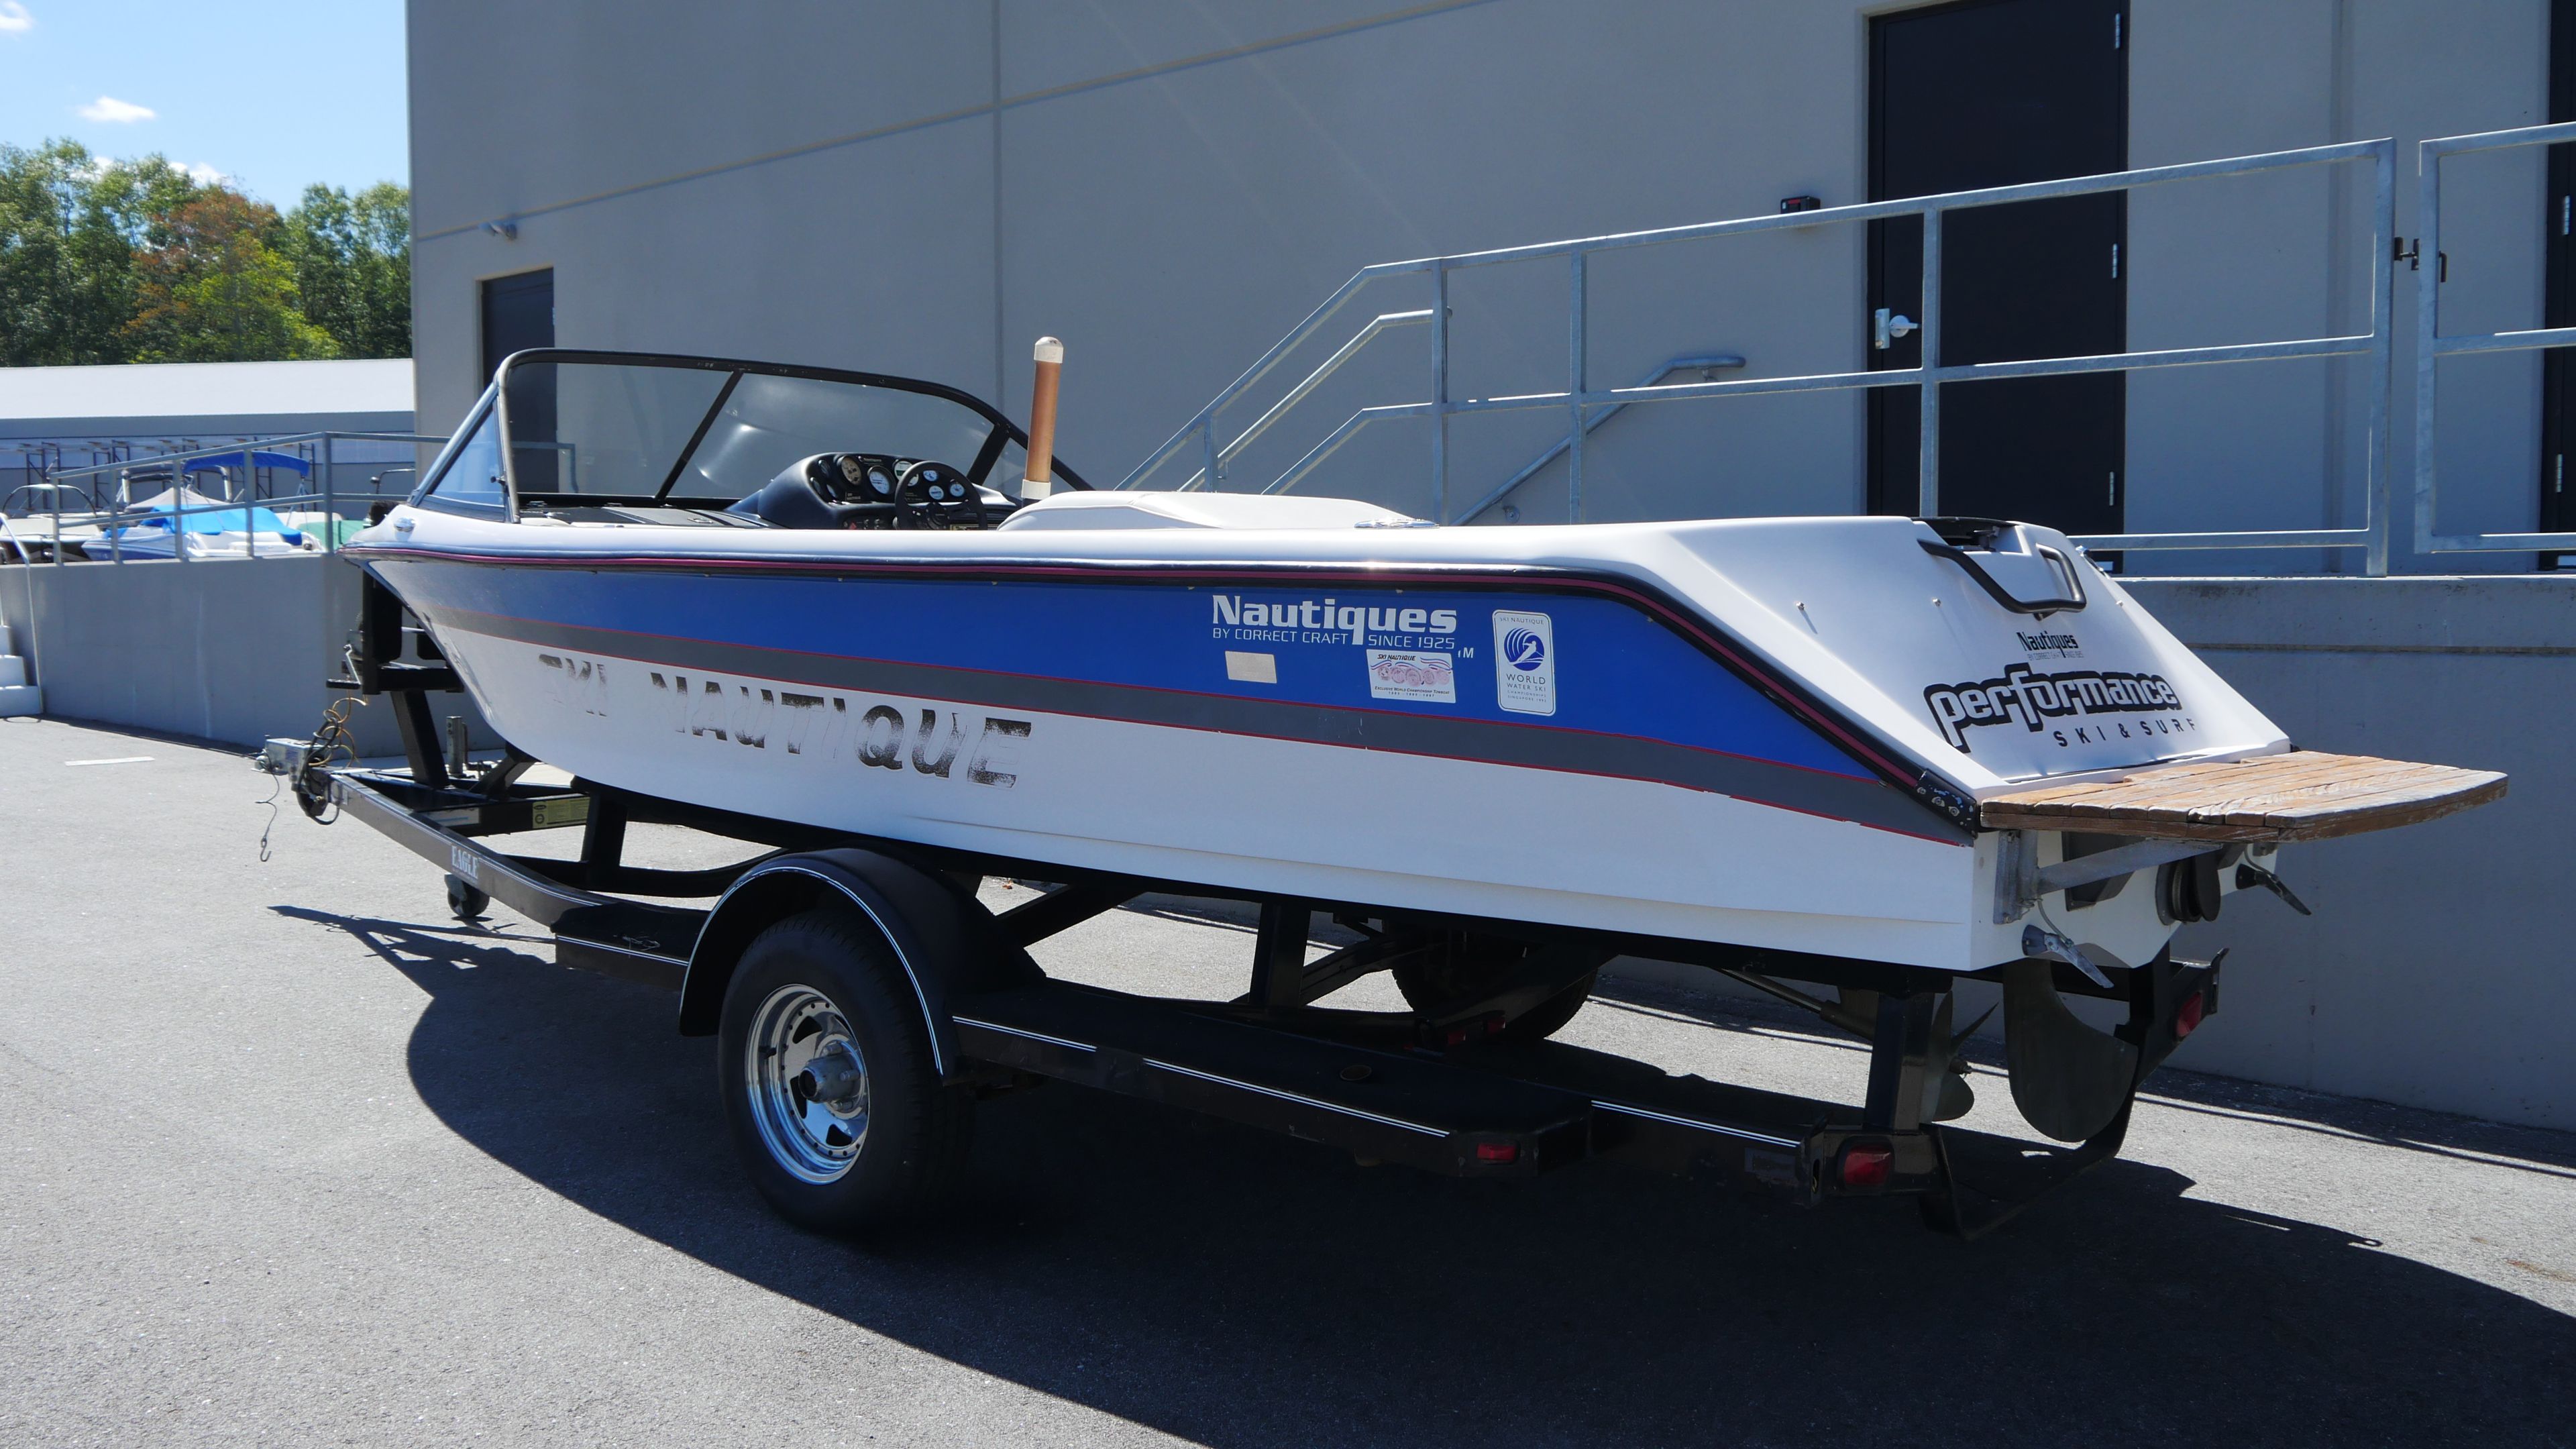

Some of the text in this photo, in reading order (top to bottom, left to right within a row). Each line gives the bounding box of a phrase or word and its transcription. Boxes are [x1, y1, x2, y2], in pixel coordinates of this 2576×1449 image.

[1212, 594, 1457, 645] Nautiques
[1213, 628, 1455, 649] BY CORRECT CRAFT SINCE 1925
[2016, 631, 2079, 658] Nautiques
[1506, 674, 1546, 684] WORLD
[1924, 663, 2182, 753] performance
[2053, 718, 2195, 747] SKI & SURF
[451, 845, 478, 879] EAGLE
